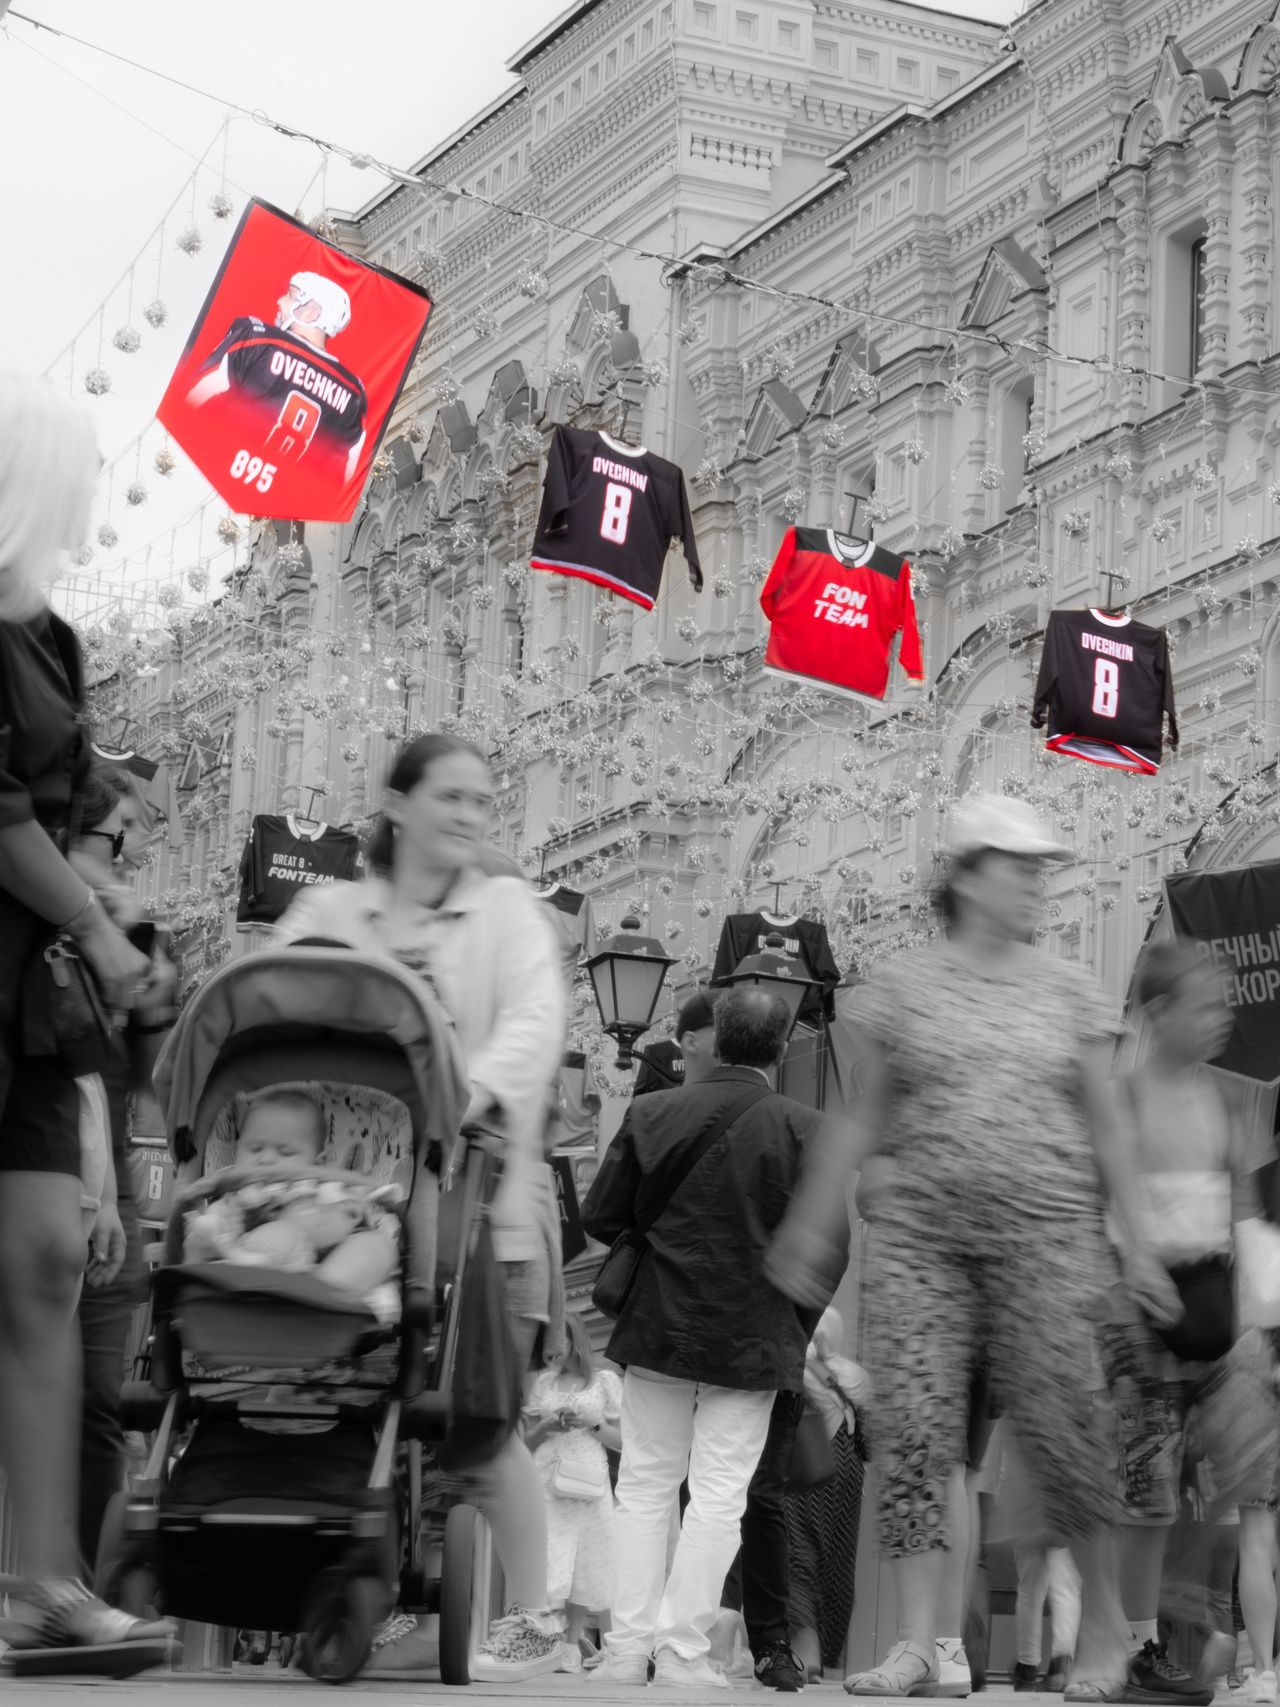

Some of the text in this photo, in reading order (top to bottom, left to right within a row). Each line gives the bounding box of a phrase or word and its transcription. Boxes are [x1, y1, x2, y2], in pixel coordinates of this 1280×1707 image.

[270, 351, 351, 414] OVECHKIN
[262, 389, 322, 465] 8
[229, 449, 277, 493] 895
[592, 456, 648, 493] OVECHKIN
[600, 482, 632, 545] 8
[813, 599, 869, 629] TEAM
[821, 582, 868, 610] FON
[1081, 632, 1134, 662] OVECHKIN
[1092, 658, 1119, 718] 8
[267, 866, 335, 886] FONTEAM
[272, 853, 298, 867] GREAT
[147, 1165, 164, 1200] 8
